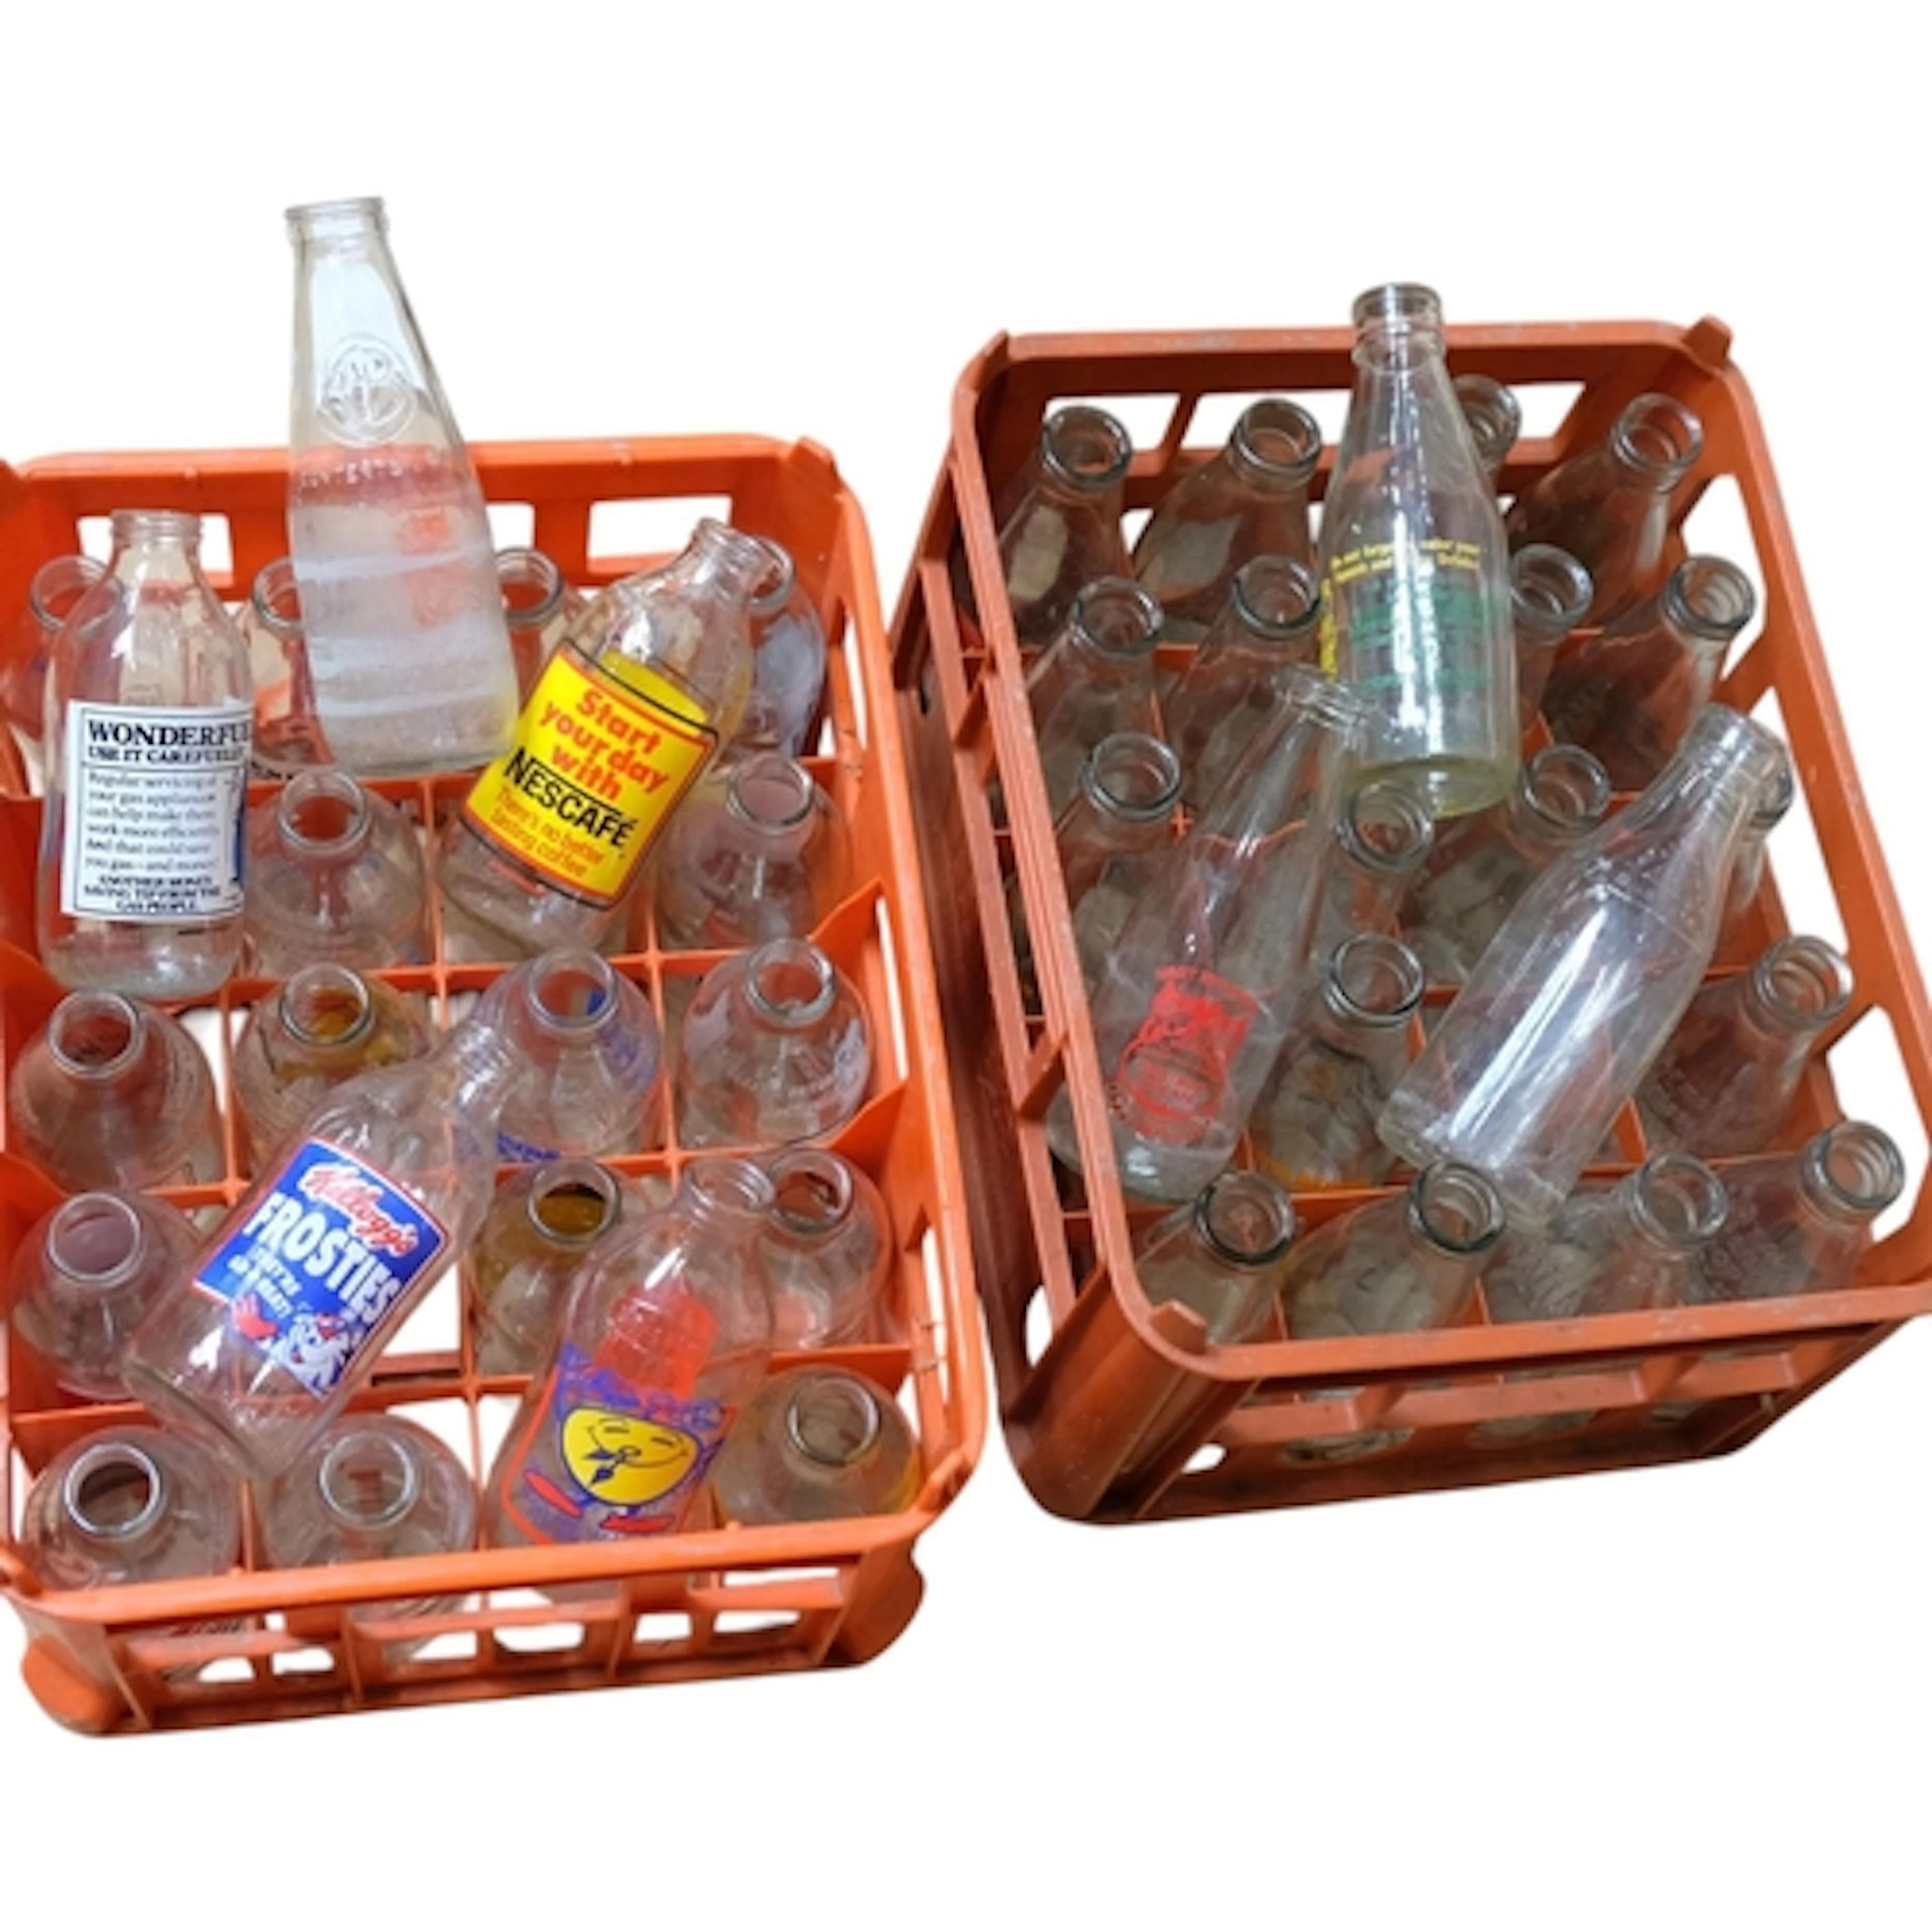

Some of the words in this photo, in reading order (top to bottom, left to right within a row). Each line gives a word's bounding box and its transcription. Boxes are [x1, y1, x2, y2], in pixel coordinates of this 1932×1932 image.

[539, 701, 609, 755] your
[608, 748, 669, 793] day
[576, 687, 663, 754] Start
[124, 749, 142, 761] IT
[552, 745, 623, 800] with
[111, 804, 143, 823] help
[503, 746, 639, 848] NESCAFÉ
[87, 823, 116, 836] work
[123, 826, 158, 838] more
[87, 838, 112, 851] And
[116, 839, 143, 853] that
[243, 1191, 401, 1325] FROSTIES
